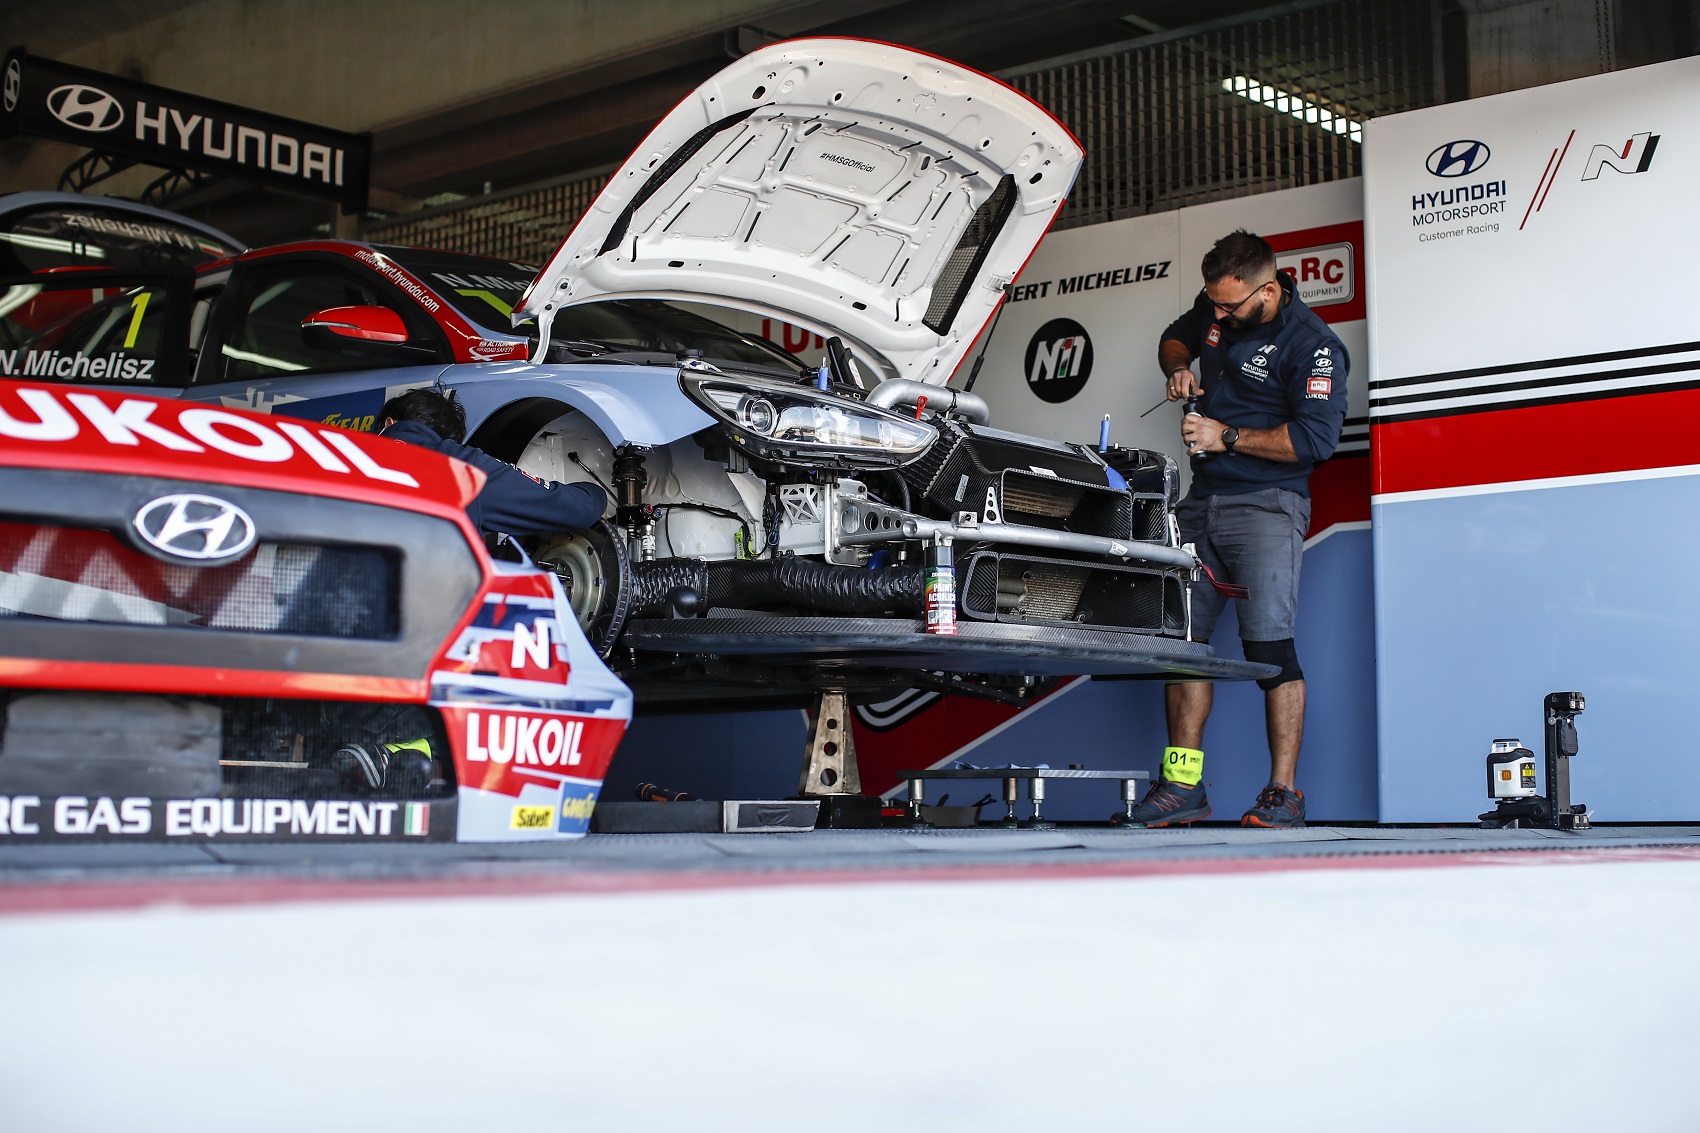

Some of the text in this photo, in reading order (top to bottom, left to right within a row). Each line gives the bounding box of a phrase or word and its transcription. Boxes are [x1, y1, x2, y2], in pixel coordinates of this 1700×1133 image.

[136, 101, 344, 187] HYUNDAI
[819, 151, 876, 173] #HMSGOfficial
[1412, 180, 1506, 211] HYUNDAI
[1412, 200, 1506, 227] MOTORSPORT
[1418, 221, 1500, 243] Customer Racing
[354, 250, 440, 313] motorsport.hyundai.com
[1057, 260, 1172, 295] MICHELISZ
[123, 292, 151, 349] 1
[1305, 393, 1329, 401] LUKOIL
[933, 583, 953, 593] PAINT
[511, 617, 551, 670] N
[466, 712, 584, 766] LUKOIL
[1169, 751, 1187, 766] 01
[54, 796, 152, 835] GAS
[165, 797, 399, 837] EQUIPMENT
